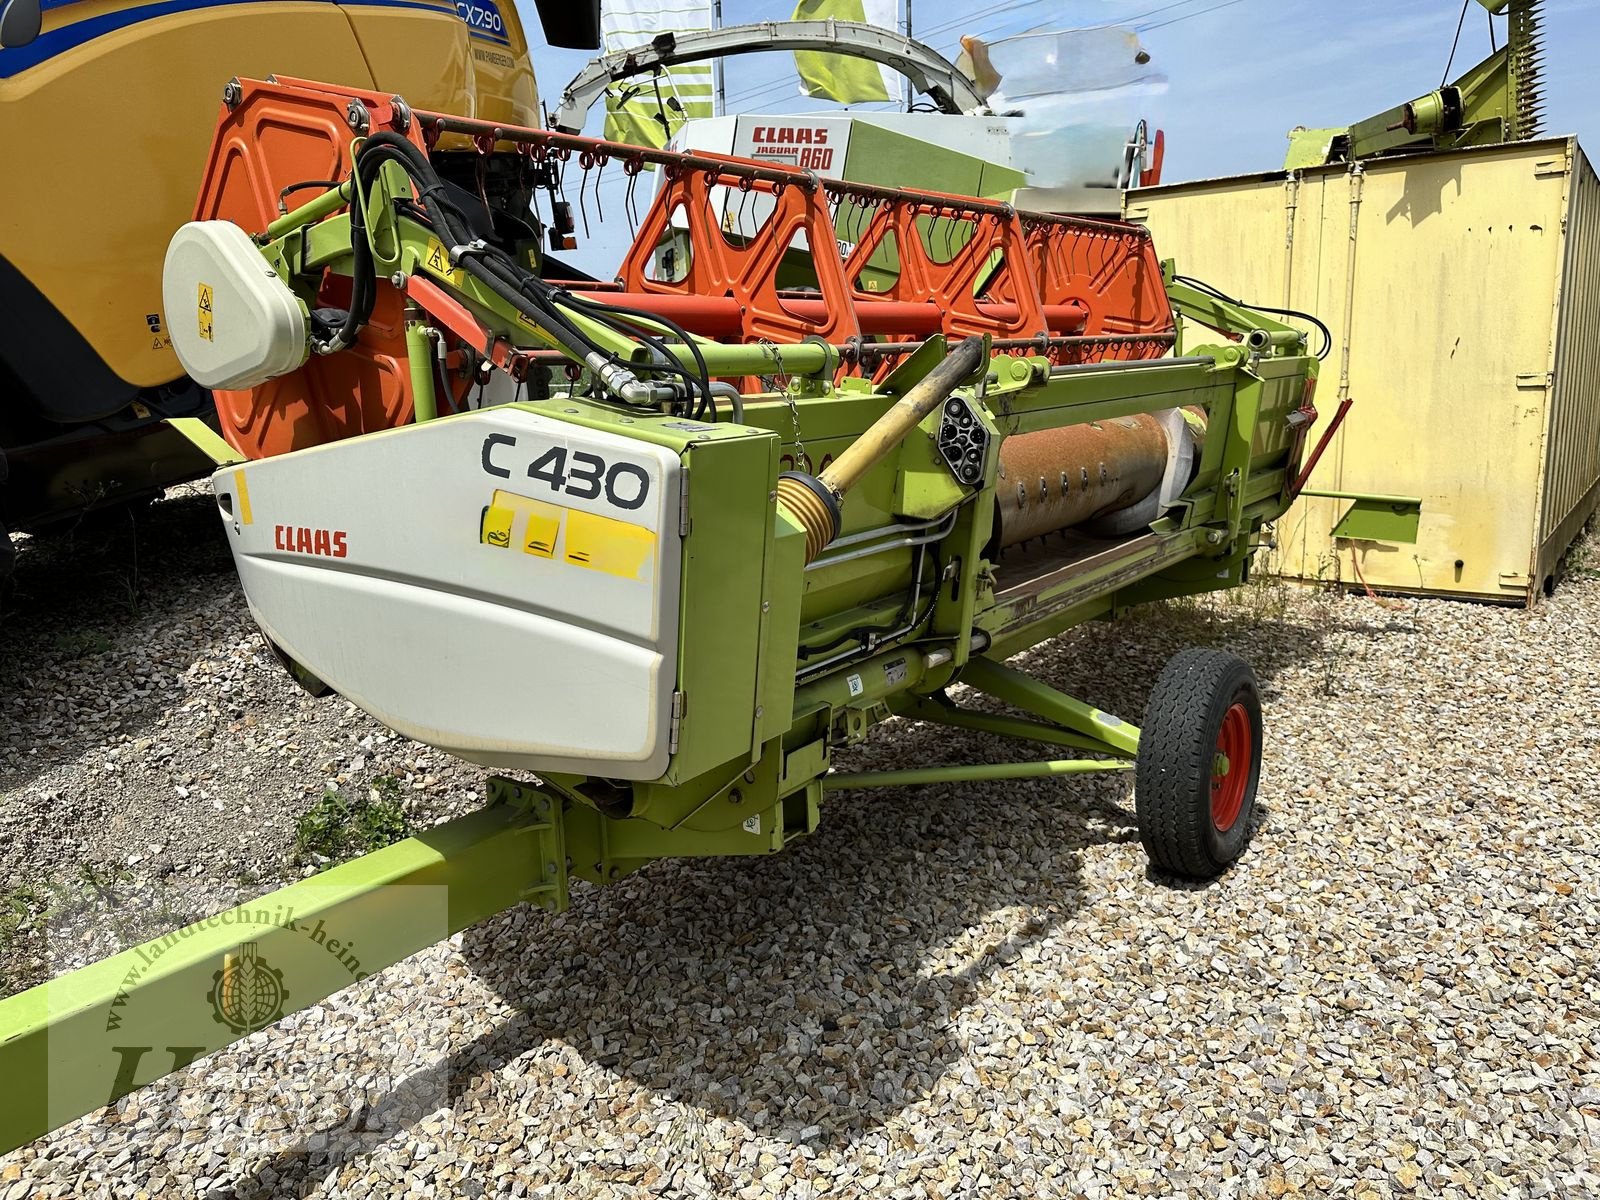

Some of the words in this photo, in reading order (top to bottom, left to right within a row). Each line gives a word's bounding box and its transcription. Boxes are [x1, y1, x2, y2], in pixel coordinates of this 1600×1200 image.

[456, 2, 501, 32] CX7.90
[752, 127, 829, 144] CLAAS
[755, 146, 800, 155] JAGUAR
[799, 147, 834, 170] 860
[481, 433, 517, 480] C
[527, 446, 650, 510] 430
[275, 525, 347, 558] CLAAS
